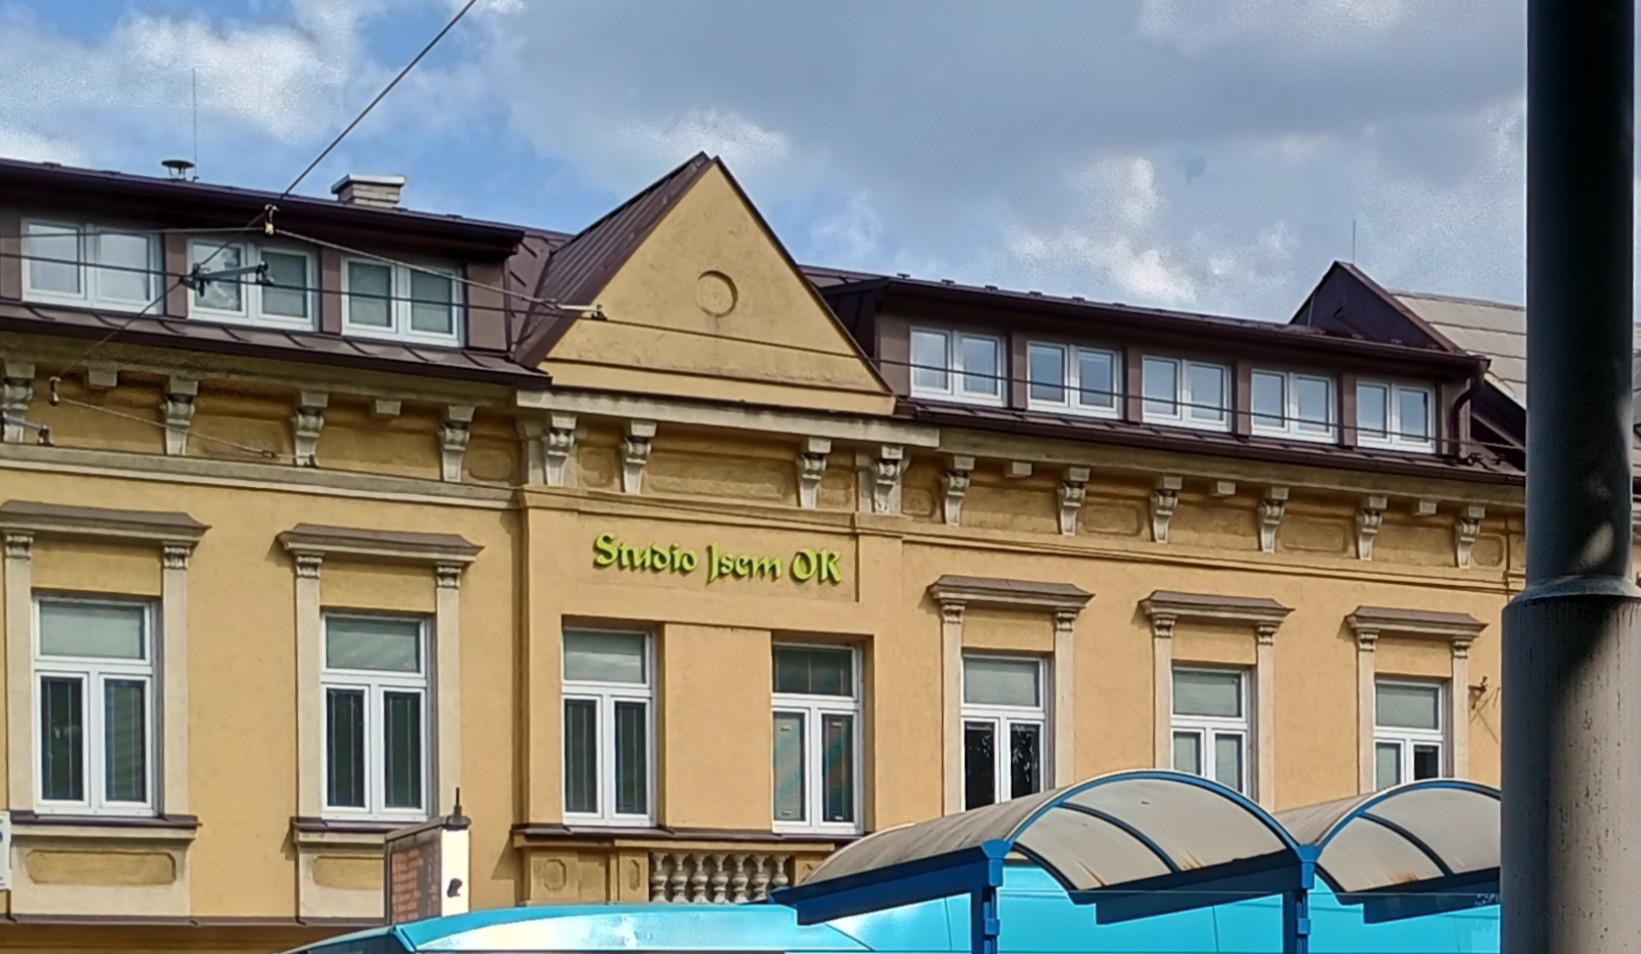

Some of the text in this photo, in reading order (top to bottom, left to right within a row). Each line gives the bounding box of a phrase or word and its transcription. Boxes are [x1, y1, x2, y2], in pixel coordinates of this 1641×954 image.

[594, 532, 843, 585] Studio Jsem OK
